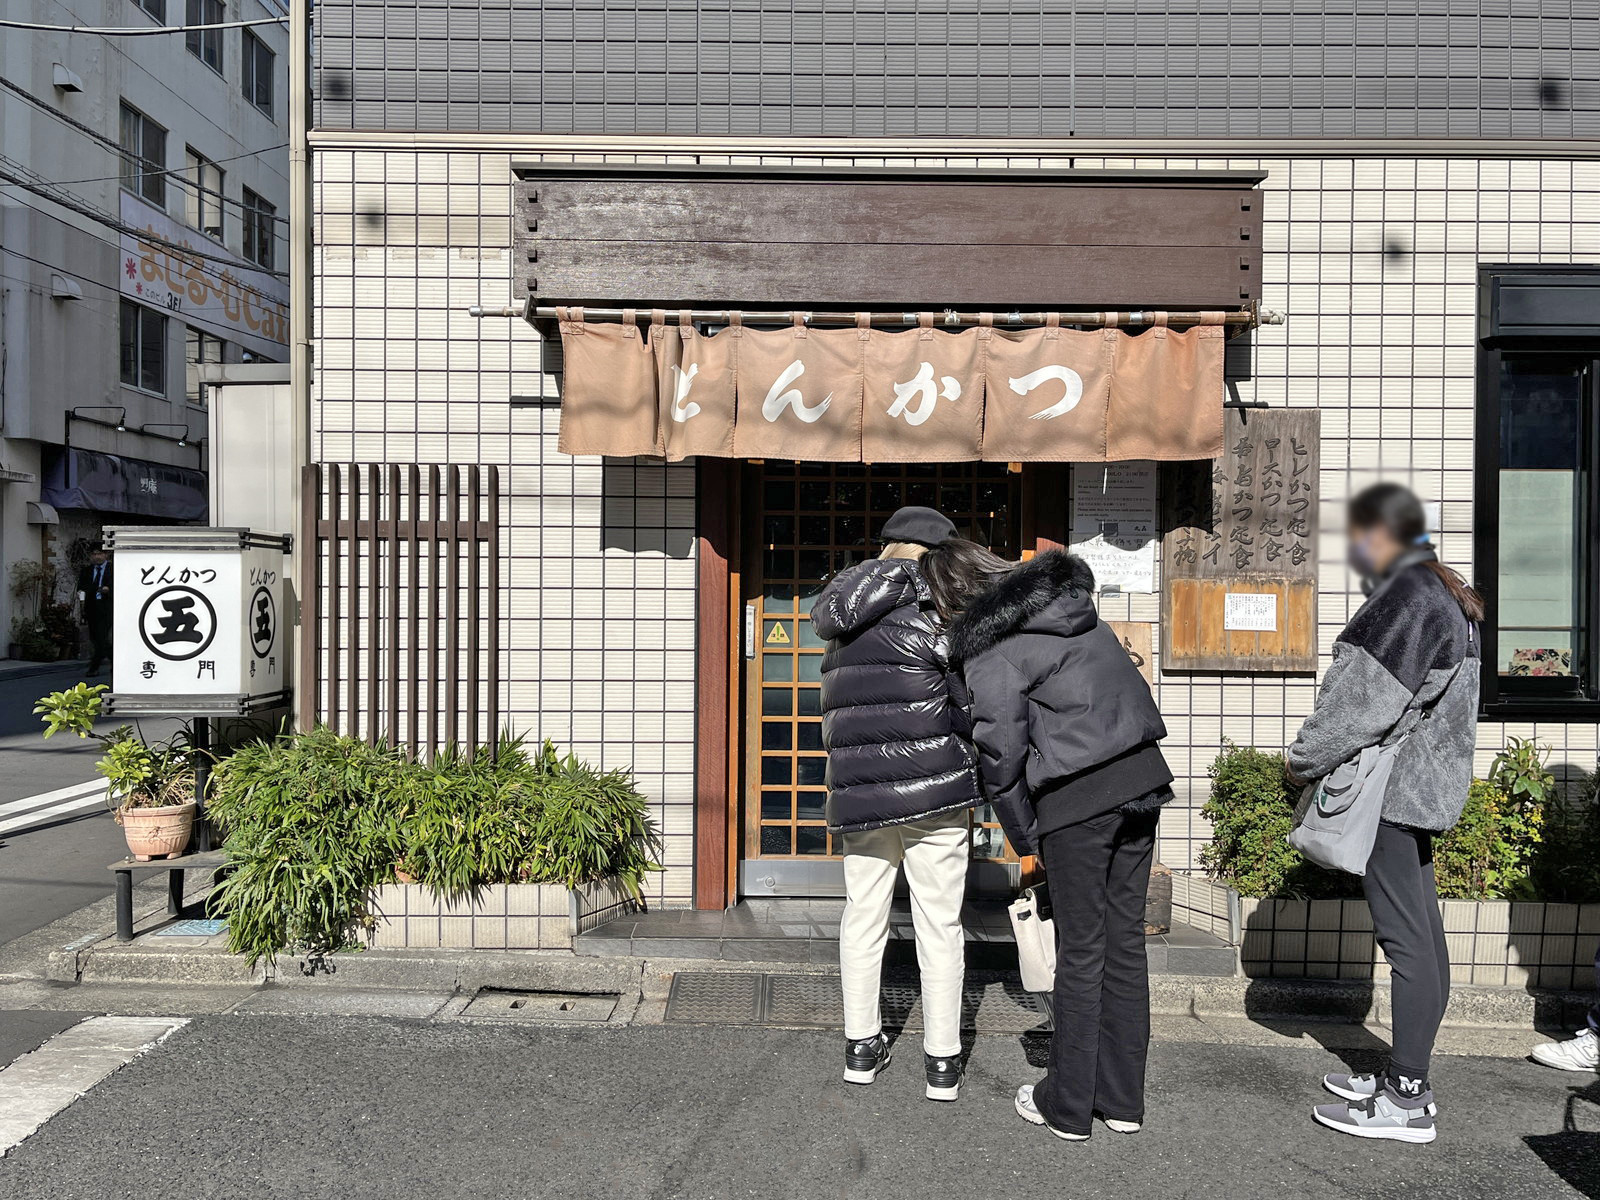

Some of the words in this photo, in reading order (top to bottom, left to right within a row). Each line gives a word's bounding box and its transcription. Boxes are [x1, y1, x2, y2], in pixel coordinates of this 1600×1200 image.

[670, 359, 1082, 426] とんかつ
[1286, 437, 1311, 566] ヒレかつ定食
[140, 566, 217, 585] とんかつ
[250, 567, 276, 586] とんかつ
[150, 595, 204, 645] 五
[253, 596, 271, 644] 五
[1398, 1075, 1422, 1094] M
